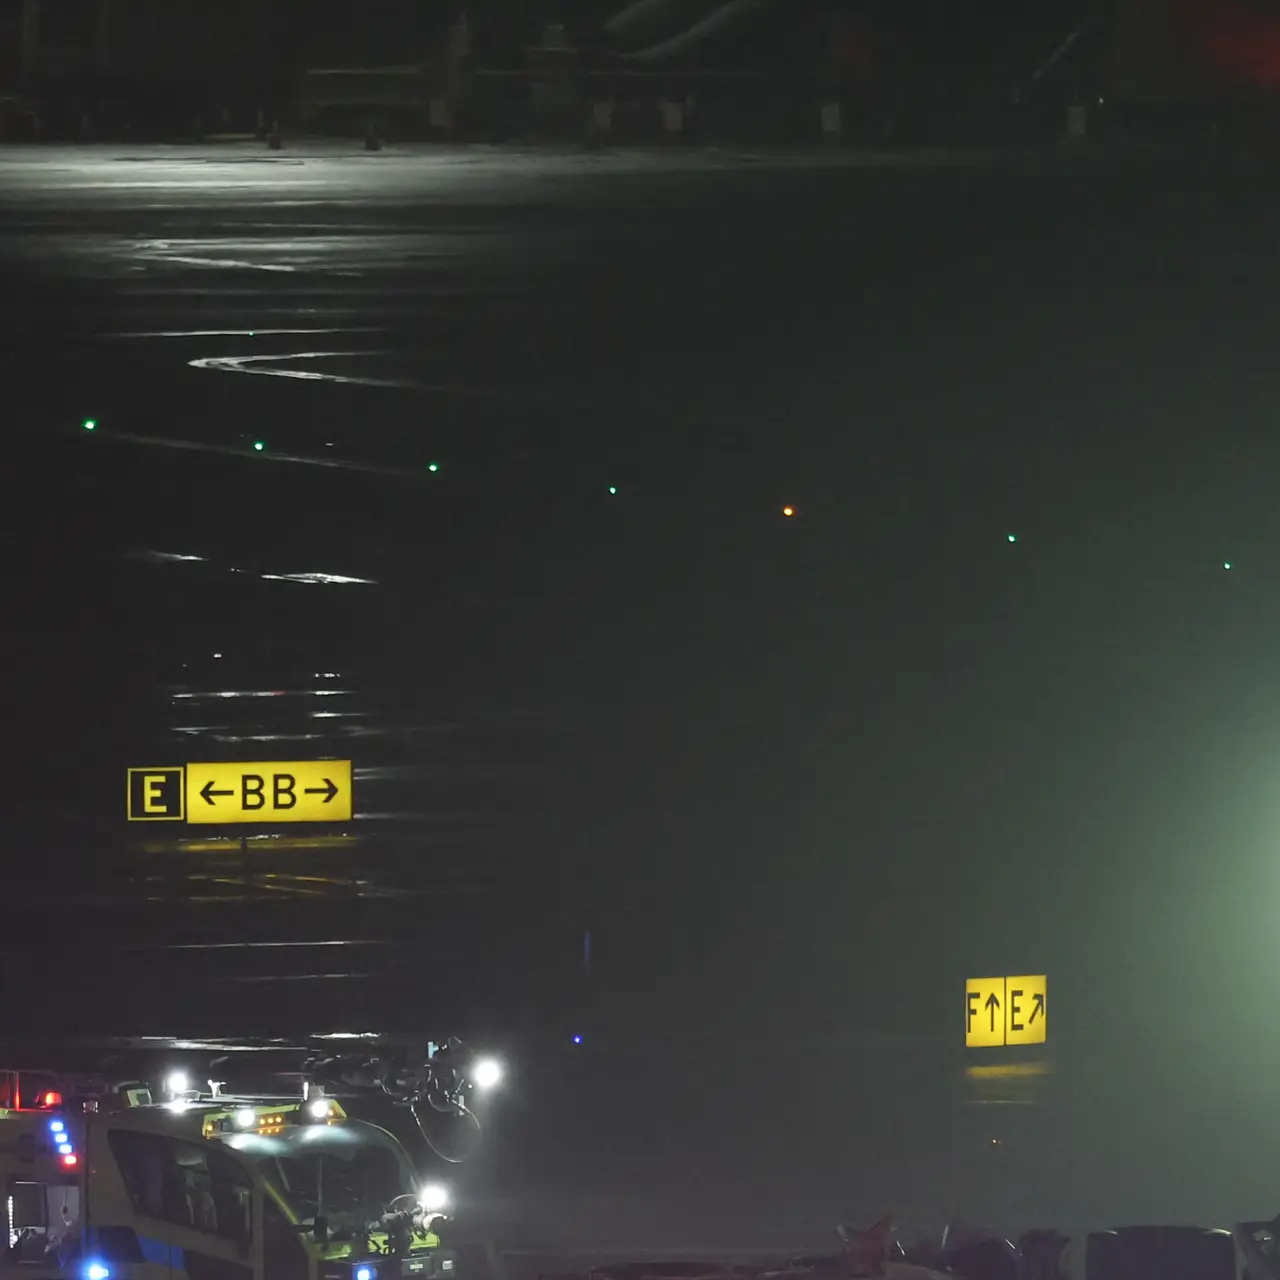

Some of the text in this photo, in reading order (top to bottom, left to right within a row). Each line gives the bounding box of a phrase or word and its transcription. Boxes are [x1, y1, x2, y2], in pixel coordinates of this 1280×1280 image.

[143, 774, 297, 813] E BB
[967, 990, 1024, 1034] F E
